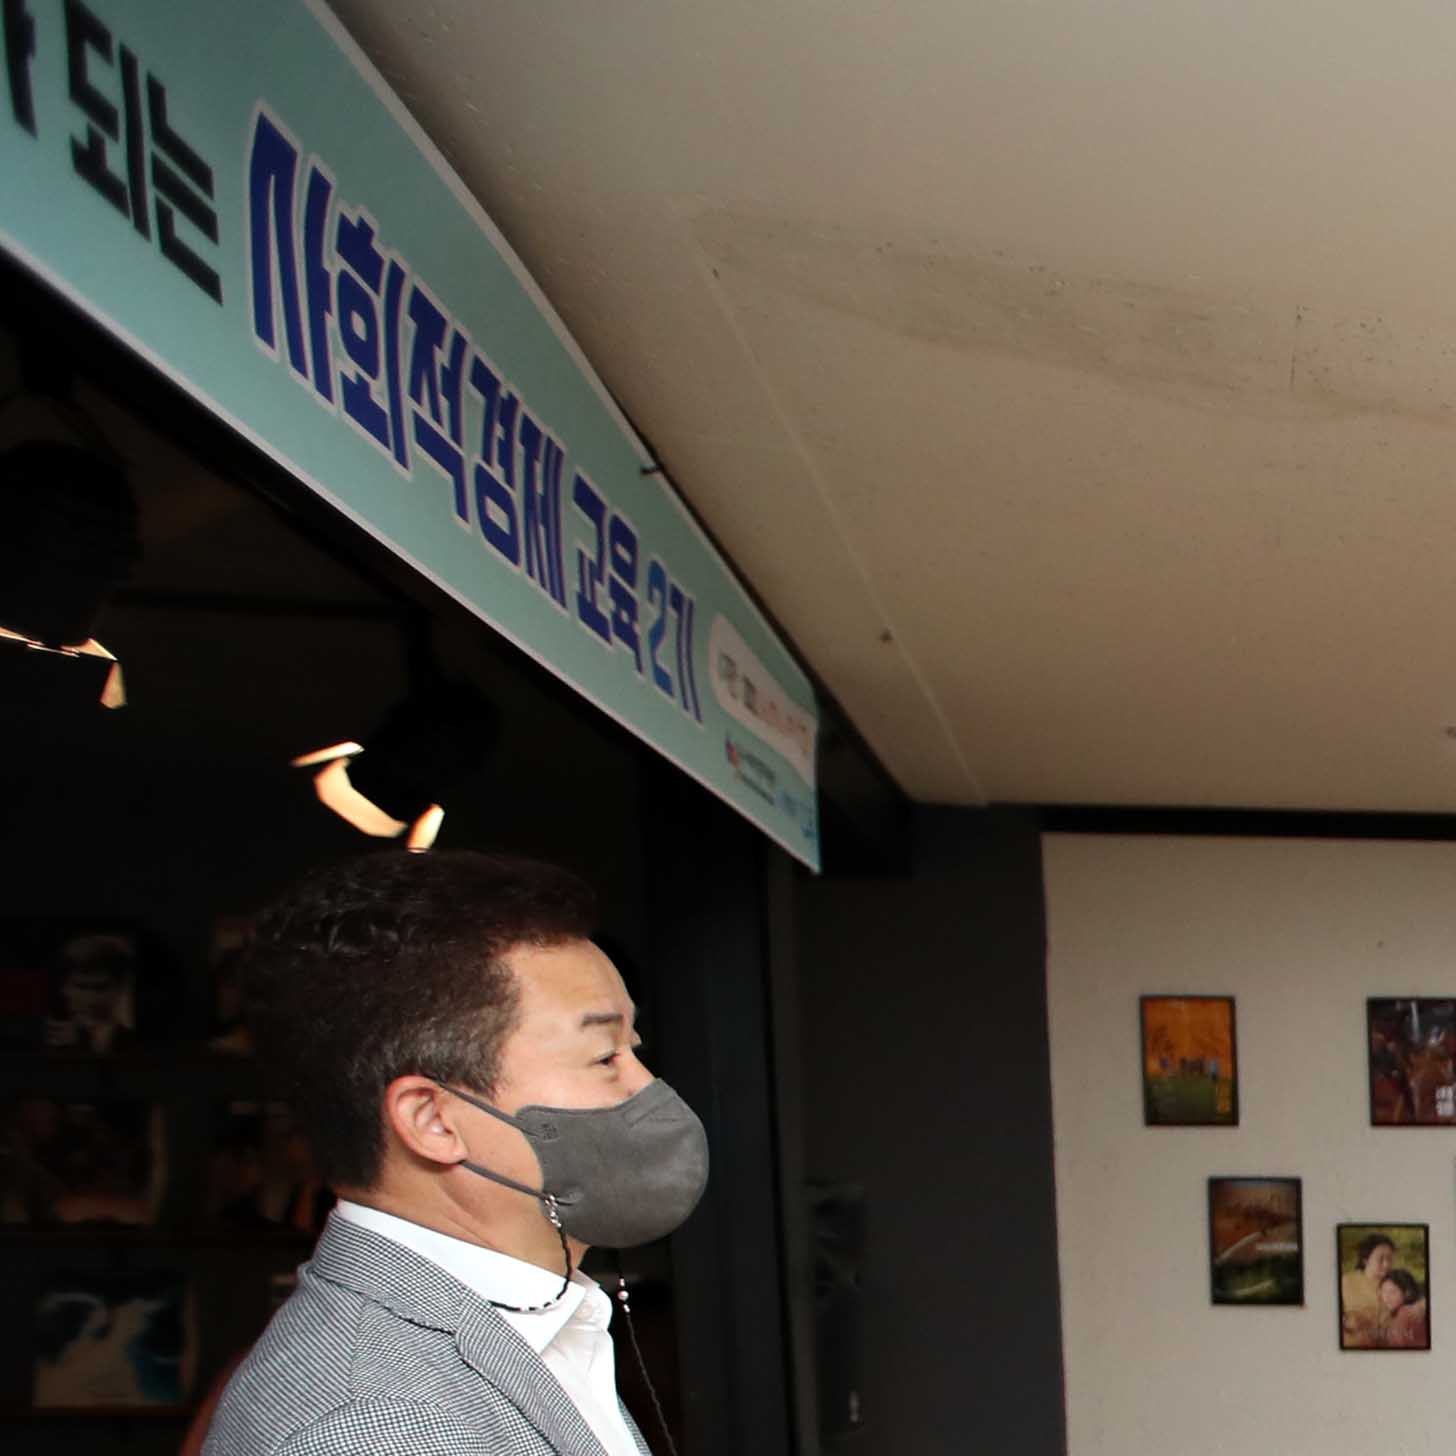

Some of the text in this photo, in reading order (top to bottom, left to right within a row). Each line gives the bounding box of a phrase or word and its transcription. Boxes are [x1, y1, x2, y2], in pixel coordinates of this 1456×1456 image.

[64, 0, 224, 308] 되는
[248, 110, 568, 611] 사회적경제
[572, 471, 645, 676] 교육
[647, 559, 703, 724] 2기
